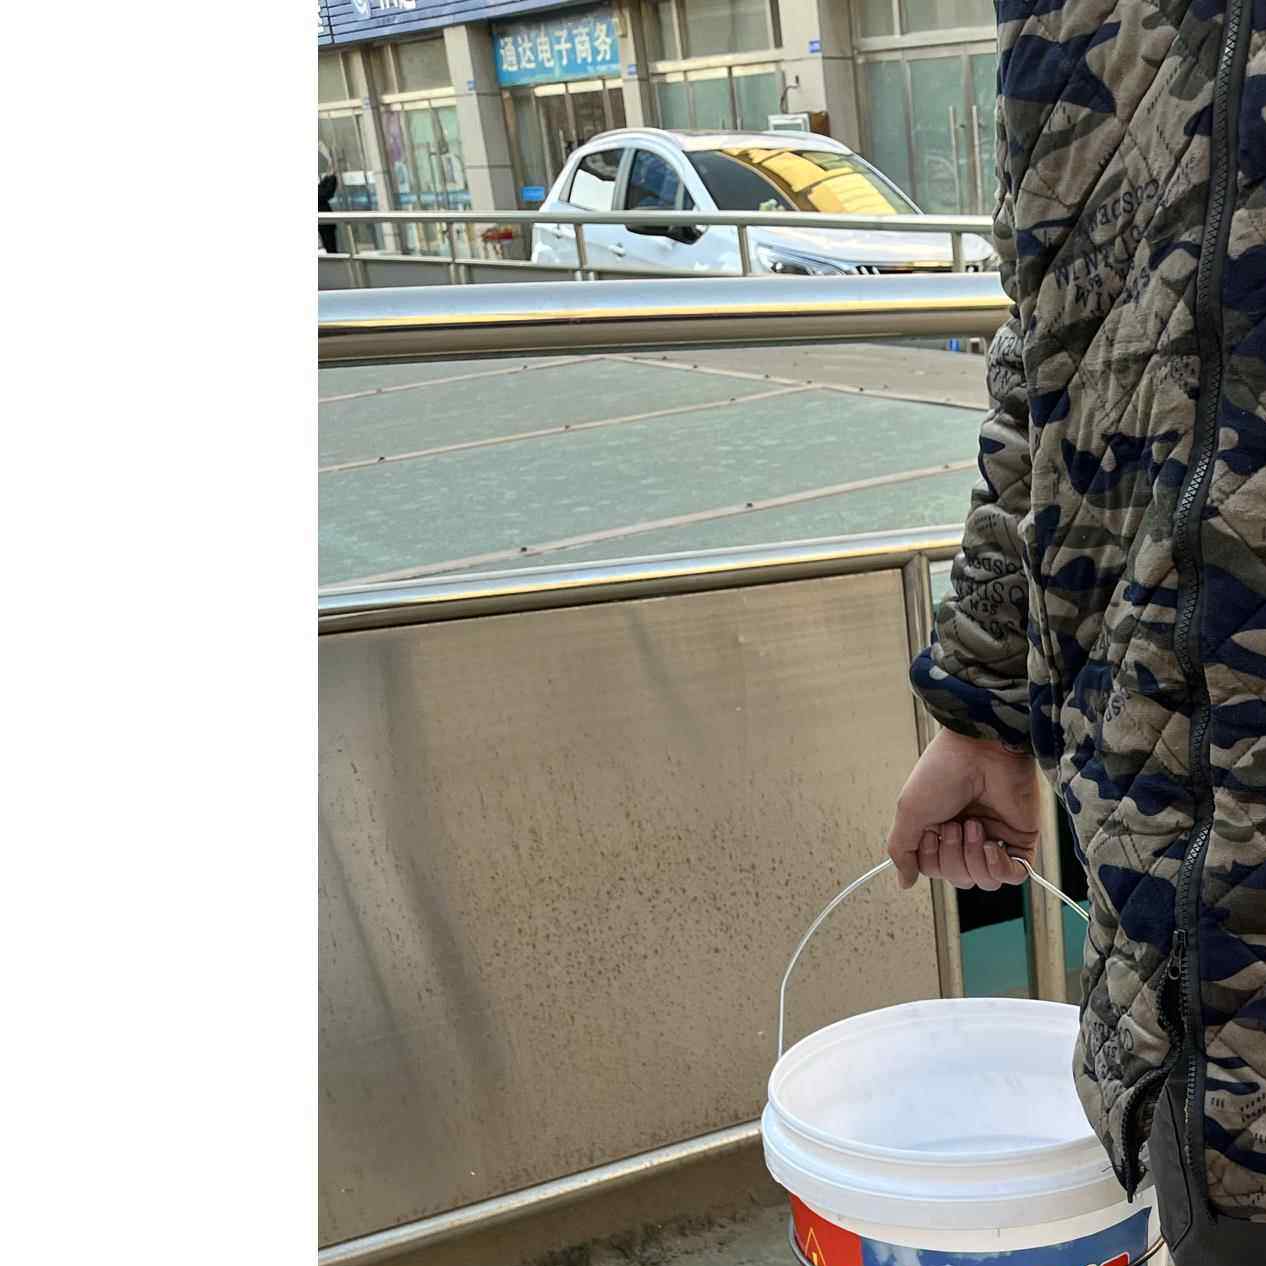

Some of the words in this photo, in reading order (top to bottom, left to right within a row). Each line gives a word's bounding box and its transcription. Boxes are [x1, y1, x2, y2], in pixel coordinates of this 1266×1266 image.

[499, 22, 613, 72] 通达电子商务
